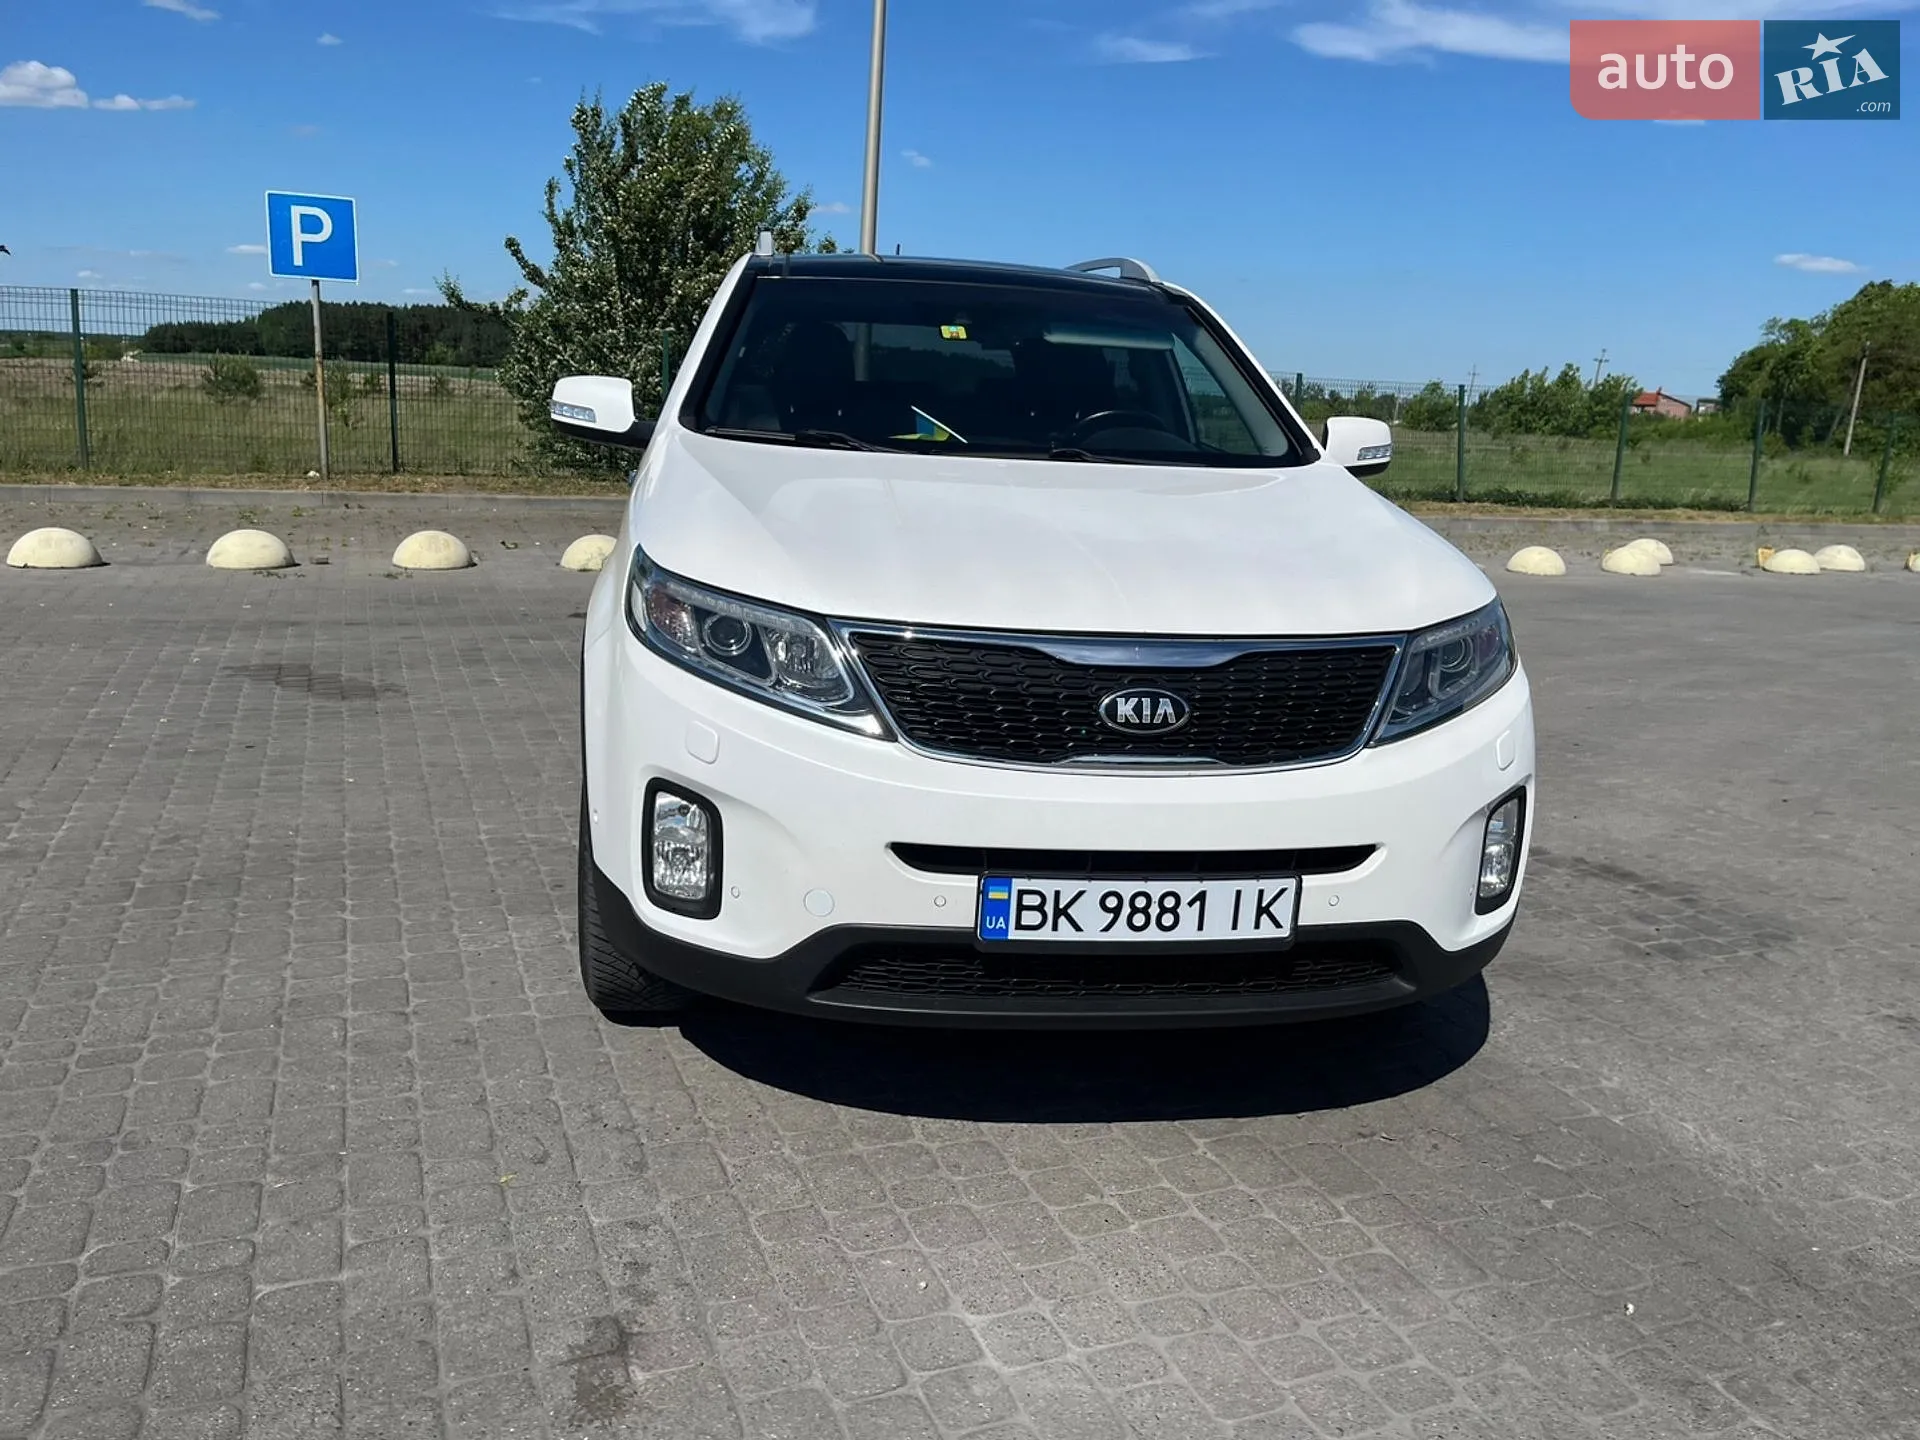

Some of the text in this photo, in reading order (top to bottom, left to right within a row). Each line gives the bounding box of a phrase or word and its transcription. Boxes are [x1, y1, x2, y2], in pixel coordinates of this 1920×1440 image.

[291, 205, 332, 266] P
[1116, 697, 1176, 724] KIA
[985, 915, 1007, 930] UA
[1014, 887, 1289, 932] BK 9881 IK
